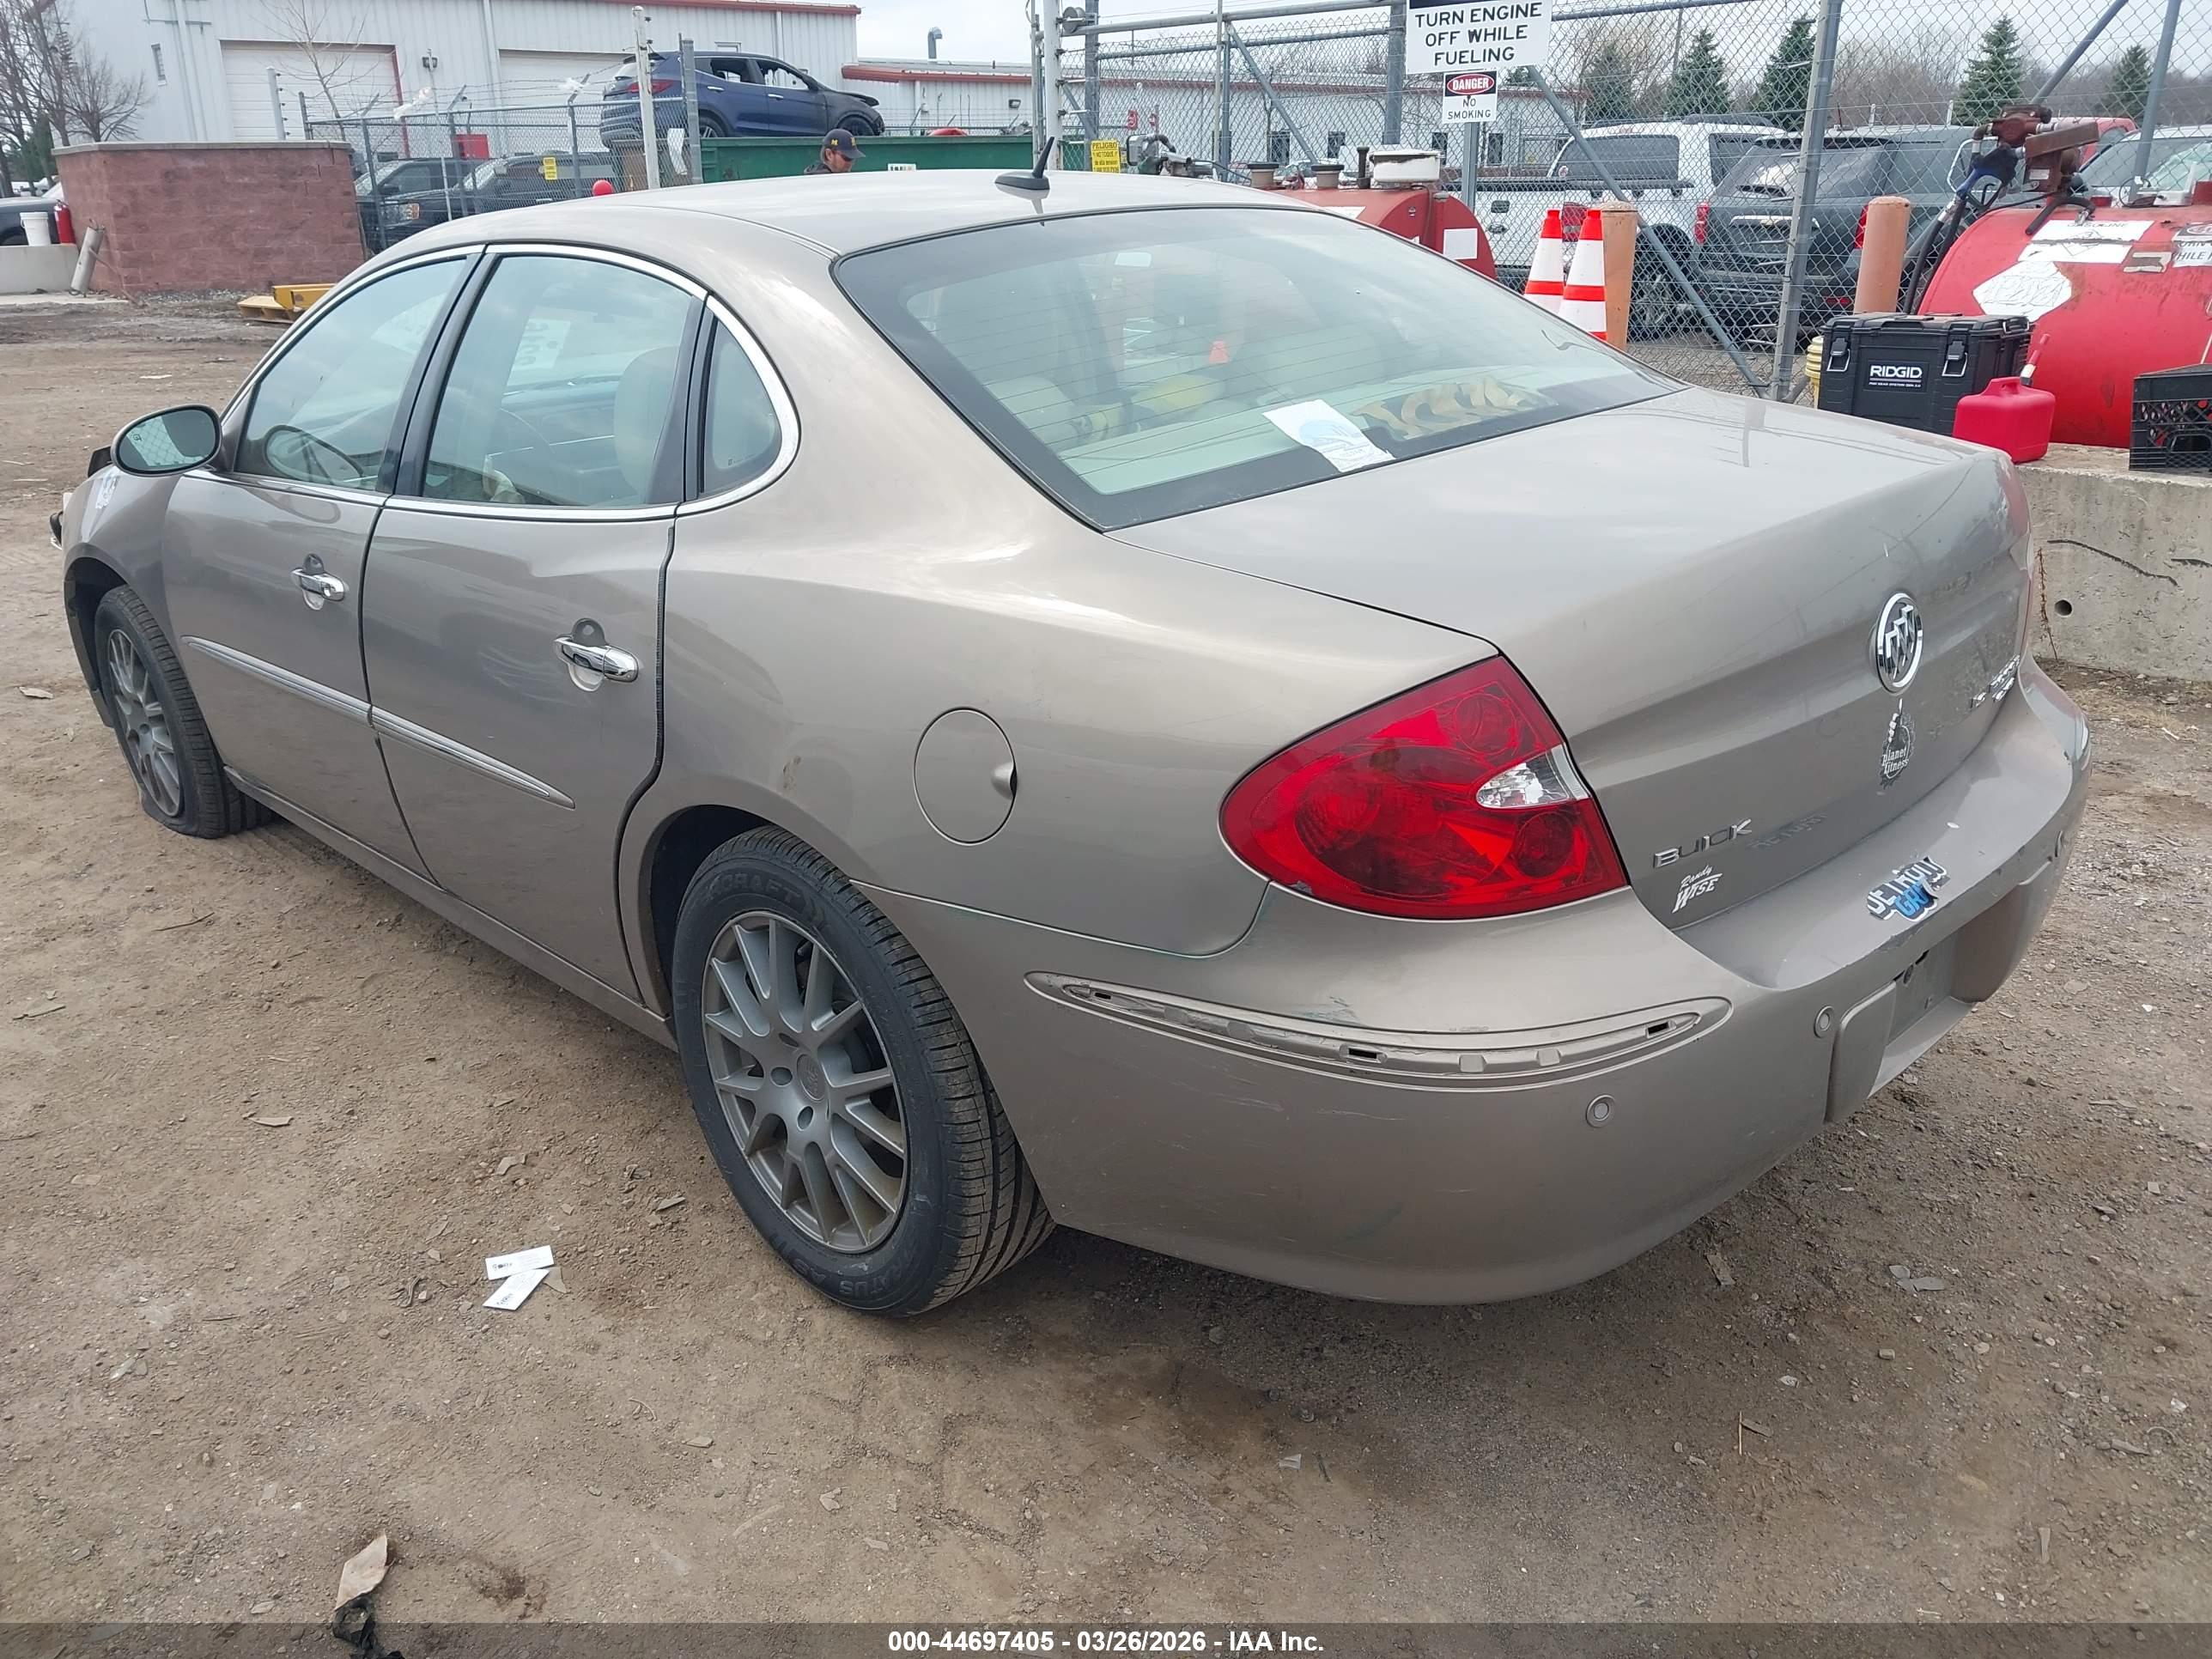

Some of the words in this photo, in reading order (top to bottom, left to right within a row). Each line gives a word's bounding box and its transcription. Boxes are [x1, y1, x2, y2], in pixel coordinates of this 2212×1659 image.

[1415, 9, 1464, 28] TURN
[1470, 2, 1542, 23] ENGINE
[1425, 30, 1461, 47] OFF
[1468, 24, 1528, 44] WHILE
[1434, 46, 1515, 66] FUELING
[1452, 77, 1489, 91] DANGER
[1462, 98, 1476, 107] NO
[1448, 109, 1492, 120] SMOKING
[1869, 365, 1923, 379] RIDGID
[1653, 818, 1753, 868] BUICK
[1680, 863, 1713, 889] Randy
[1672, 874, 1722, 914] WISE
